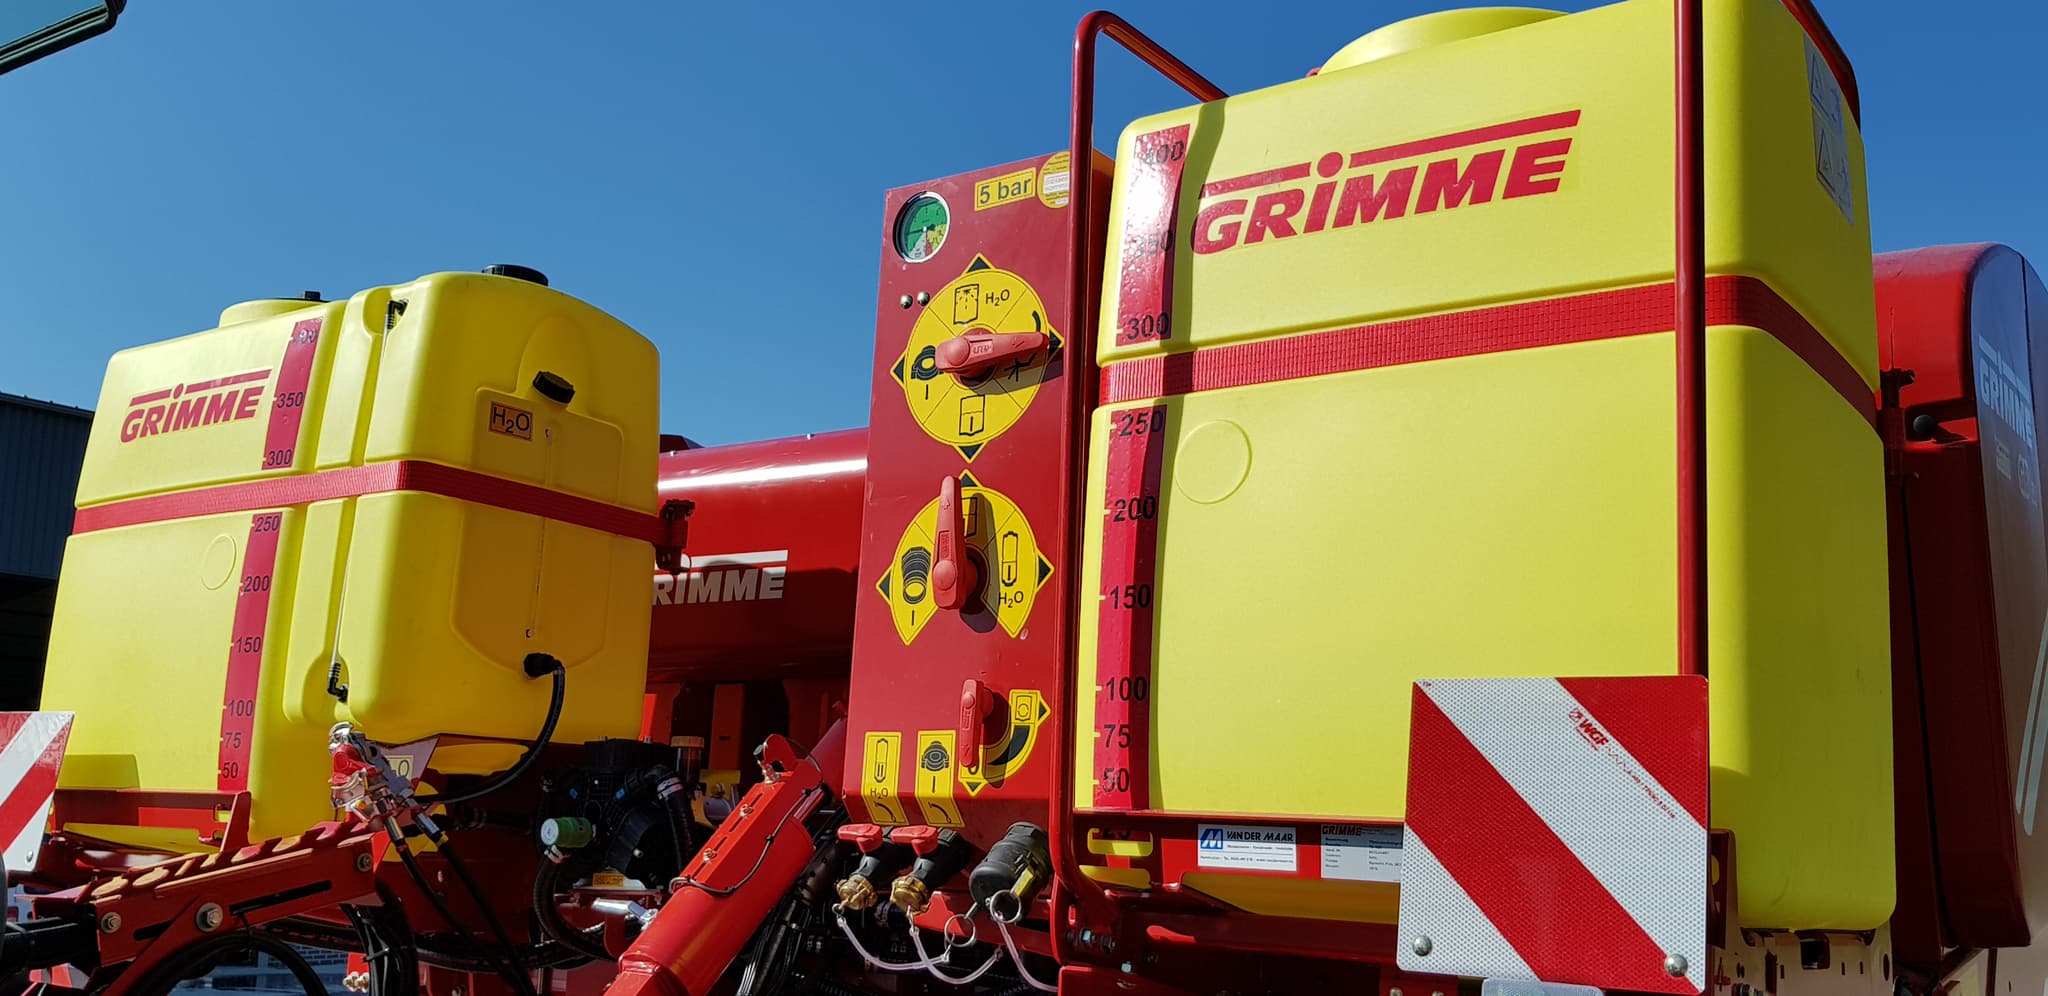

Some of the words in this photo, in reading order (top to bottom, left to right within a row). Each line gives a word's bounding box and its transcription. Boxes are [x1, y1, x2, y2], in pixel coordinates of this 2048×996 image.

[979, 185, 991, 204] 5
[998, 178, 1031, 200] bar
[1191, 138, 1573, 254] GRIMME
[1127, 313, 1170, 340] 300
[277, 391, 304, 408] 350
[1979, 352, 2034, 450] GRIMME
[120, 383, 265, 443] GRIMME
[1120, 410, 1164, 437] 250
[267, 449, 292, 466] 300
[1113, 496, 1157, 522] 200
[255, 515, 280, 532] 250
[244, 575, 270, 593] 200
[653, 566, 787, 606] RIMME
[1110, 584, 1152, 609] 150
[237, 636, 262, 653] 150
[1105, 676, 1147, 701] 100
[228, 699, 254, 717] 100
[225, 732, 242, 749] 75
[1103, 724, 1131, 748] 75
[222, 762, 239, 779] 50
[1103, 768, 1130, 792] 50
[1263, 832, 1294, 842] MAAR
[1321, 825, 1362, 836] GRIMME
